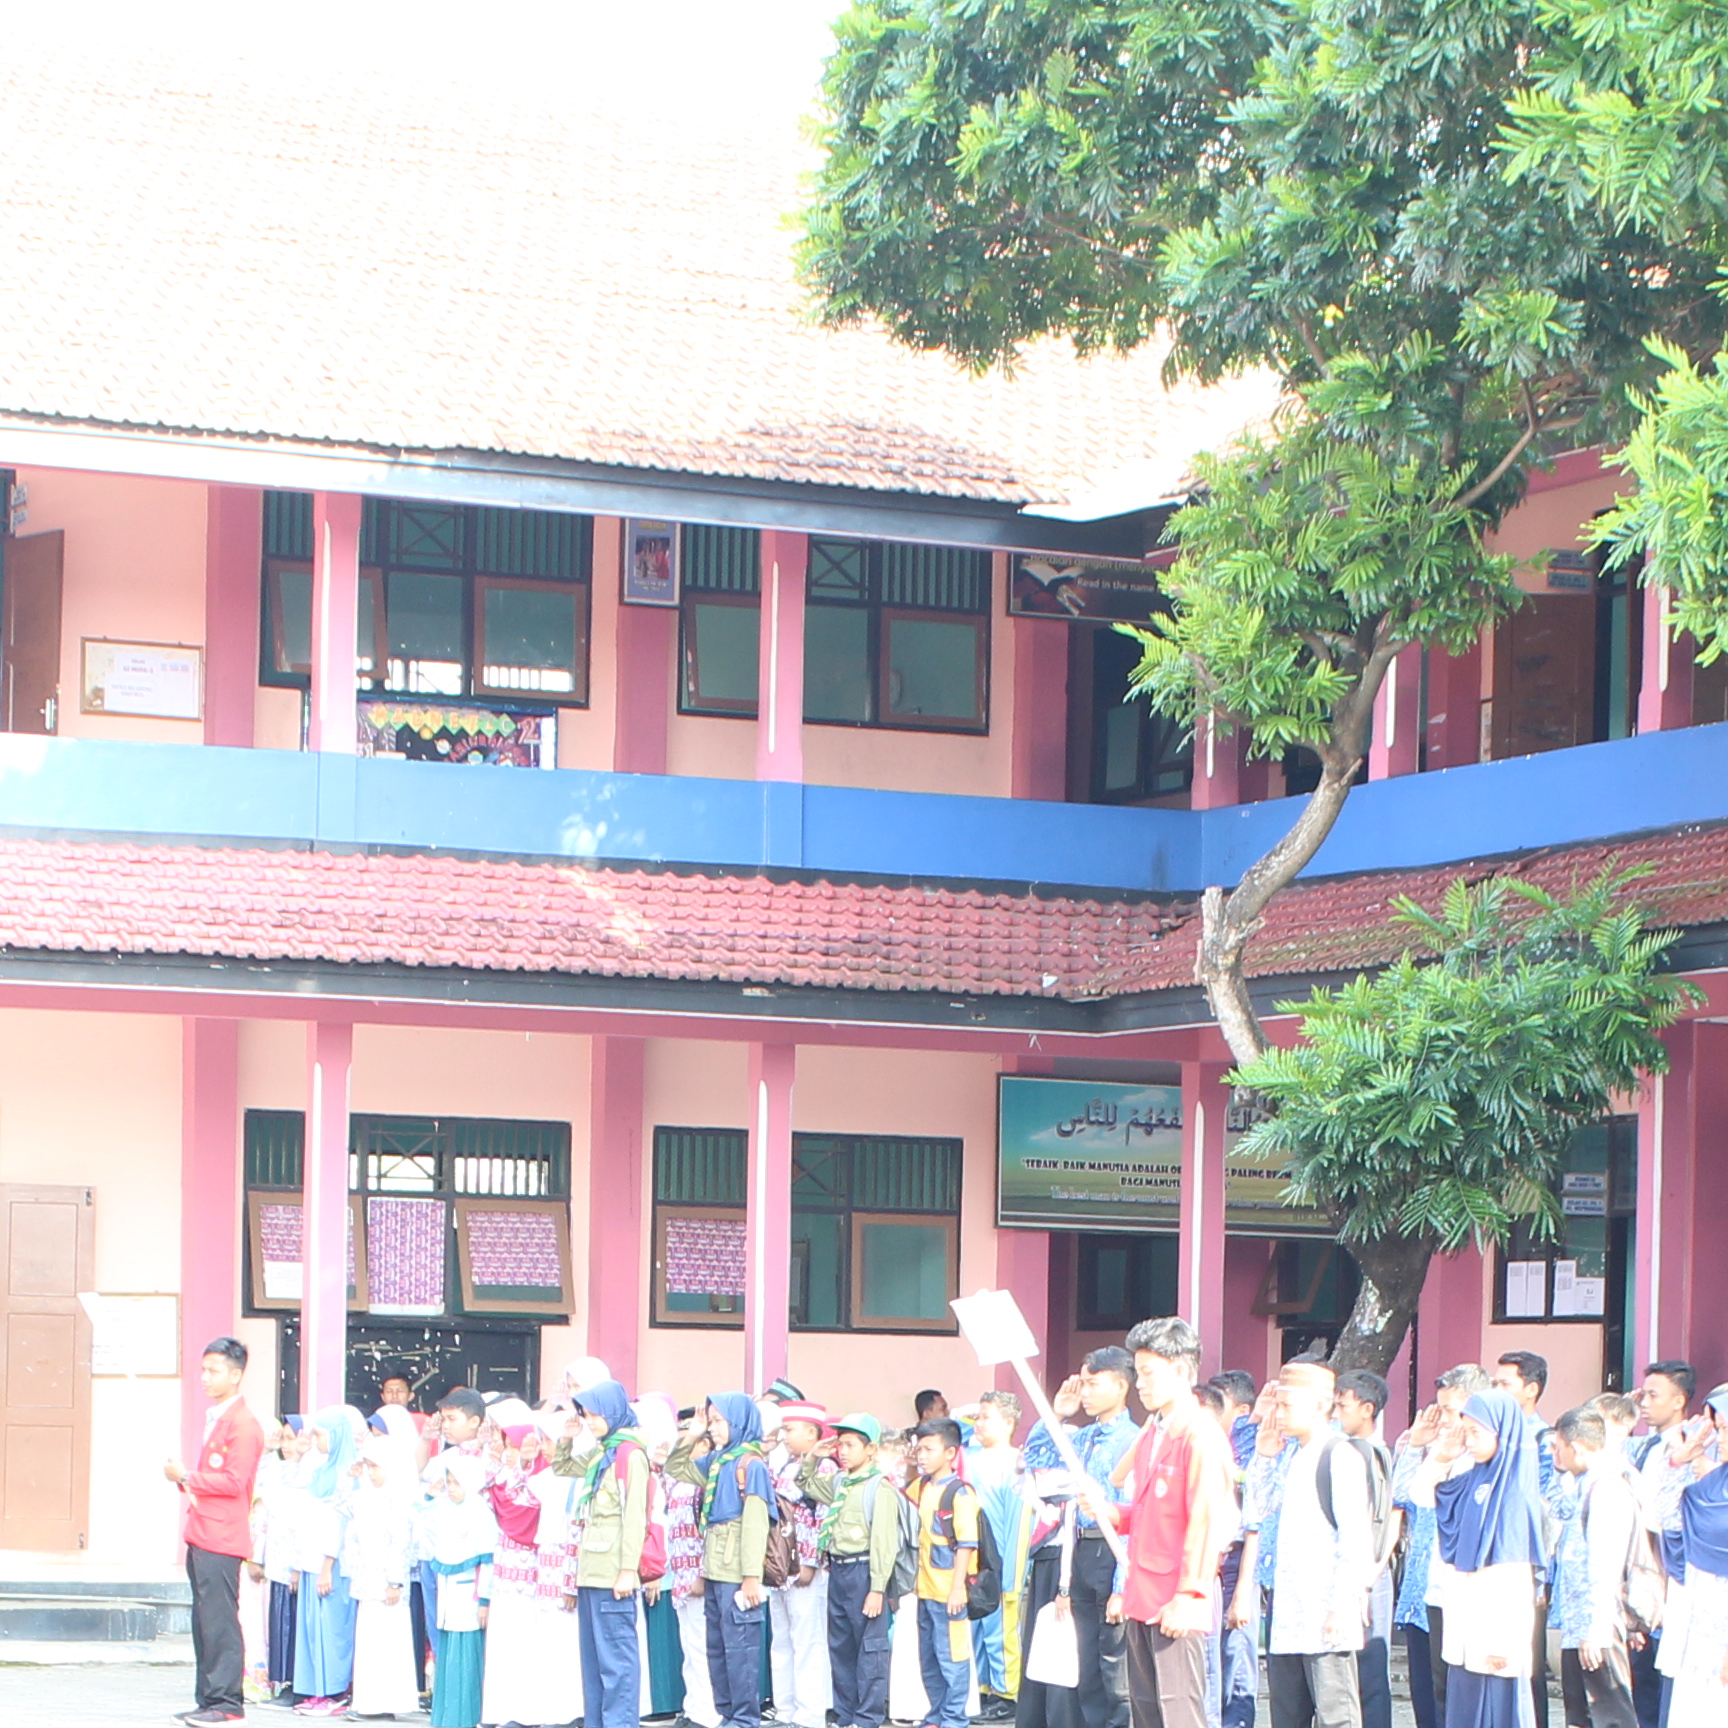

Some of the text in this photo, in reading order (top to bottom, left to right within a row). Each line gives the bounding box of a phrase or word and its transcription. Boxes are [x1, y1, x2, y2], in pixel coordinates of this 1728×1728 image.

[1077, 577, 1156, 592] Read in the name
[1131, 1163, 1168, 1174] ADALAH
[1145, 1177, 1181, 1188] MANUSI
